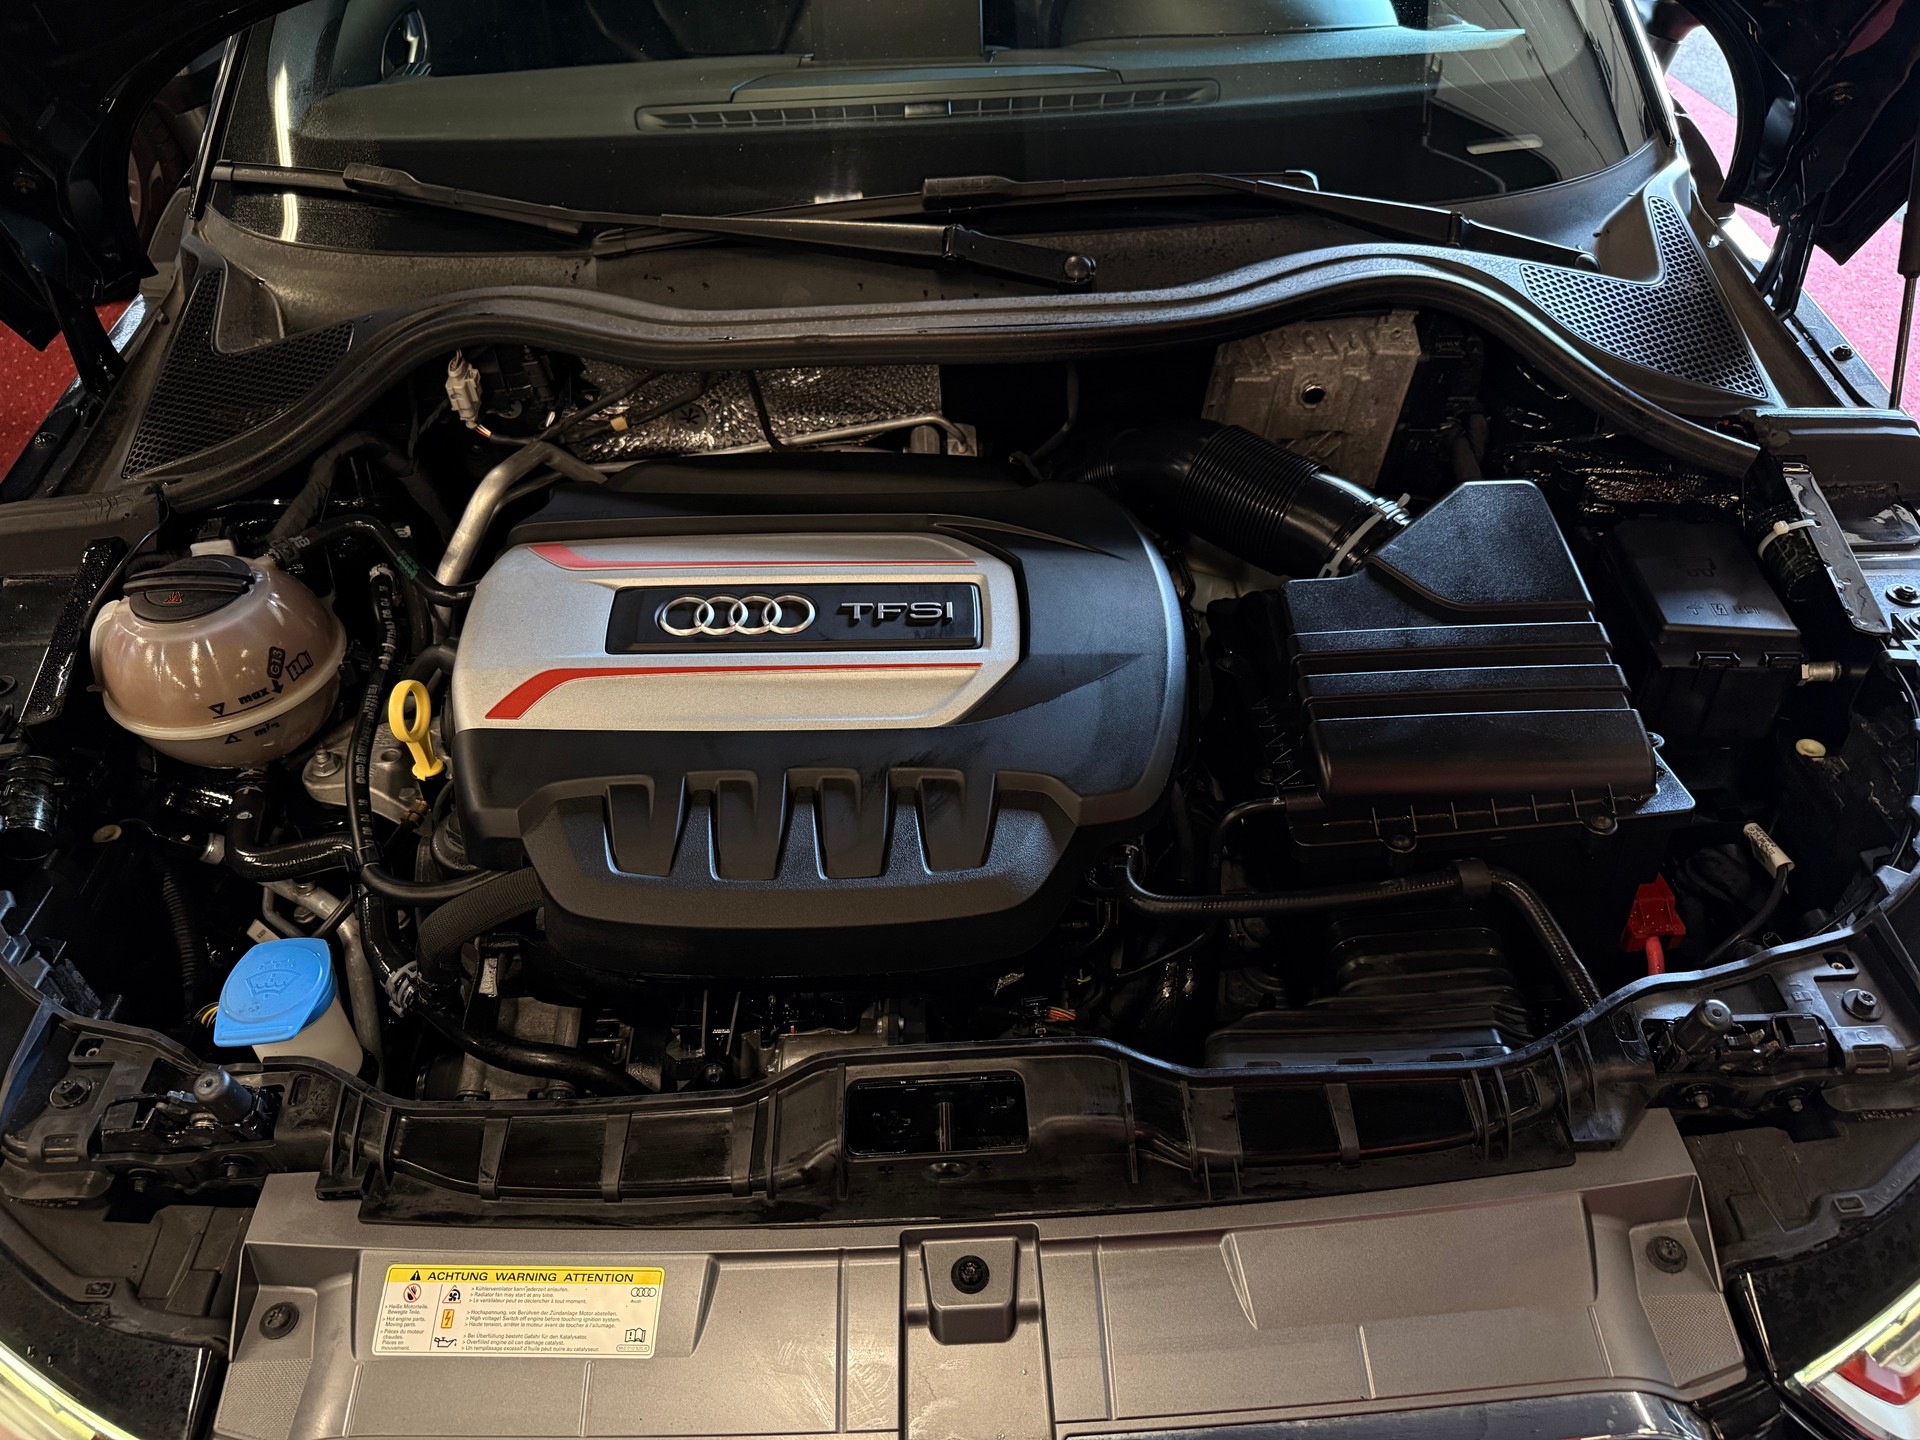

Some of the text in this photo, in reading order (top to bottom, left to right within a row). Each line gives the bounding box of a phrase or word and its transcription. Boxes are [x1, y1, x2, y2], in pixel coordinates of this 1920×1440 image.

[841, 602, 954, 621] TFSI
[270, 649, 283, 675] G13
[238, 688, 270, 704] max
[428, 1272, 634, 1282] ACHTUNG WARNING ATTENTION
